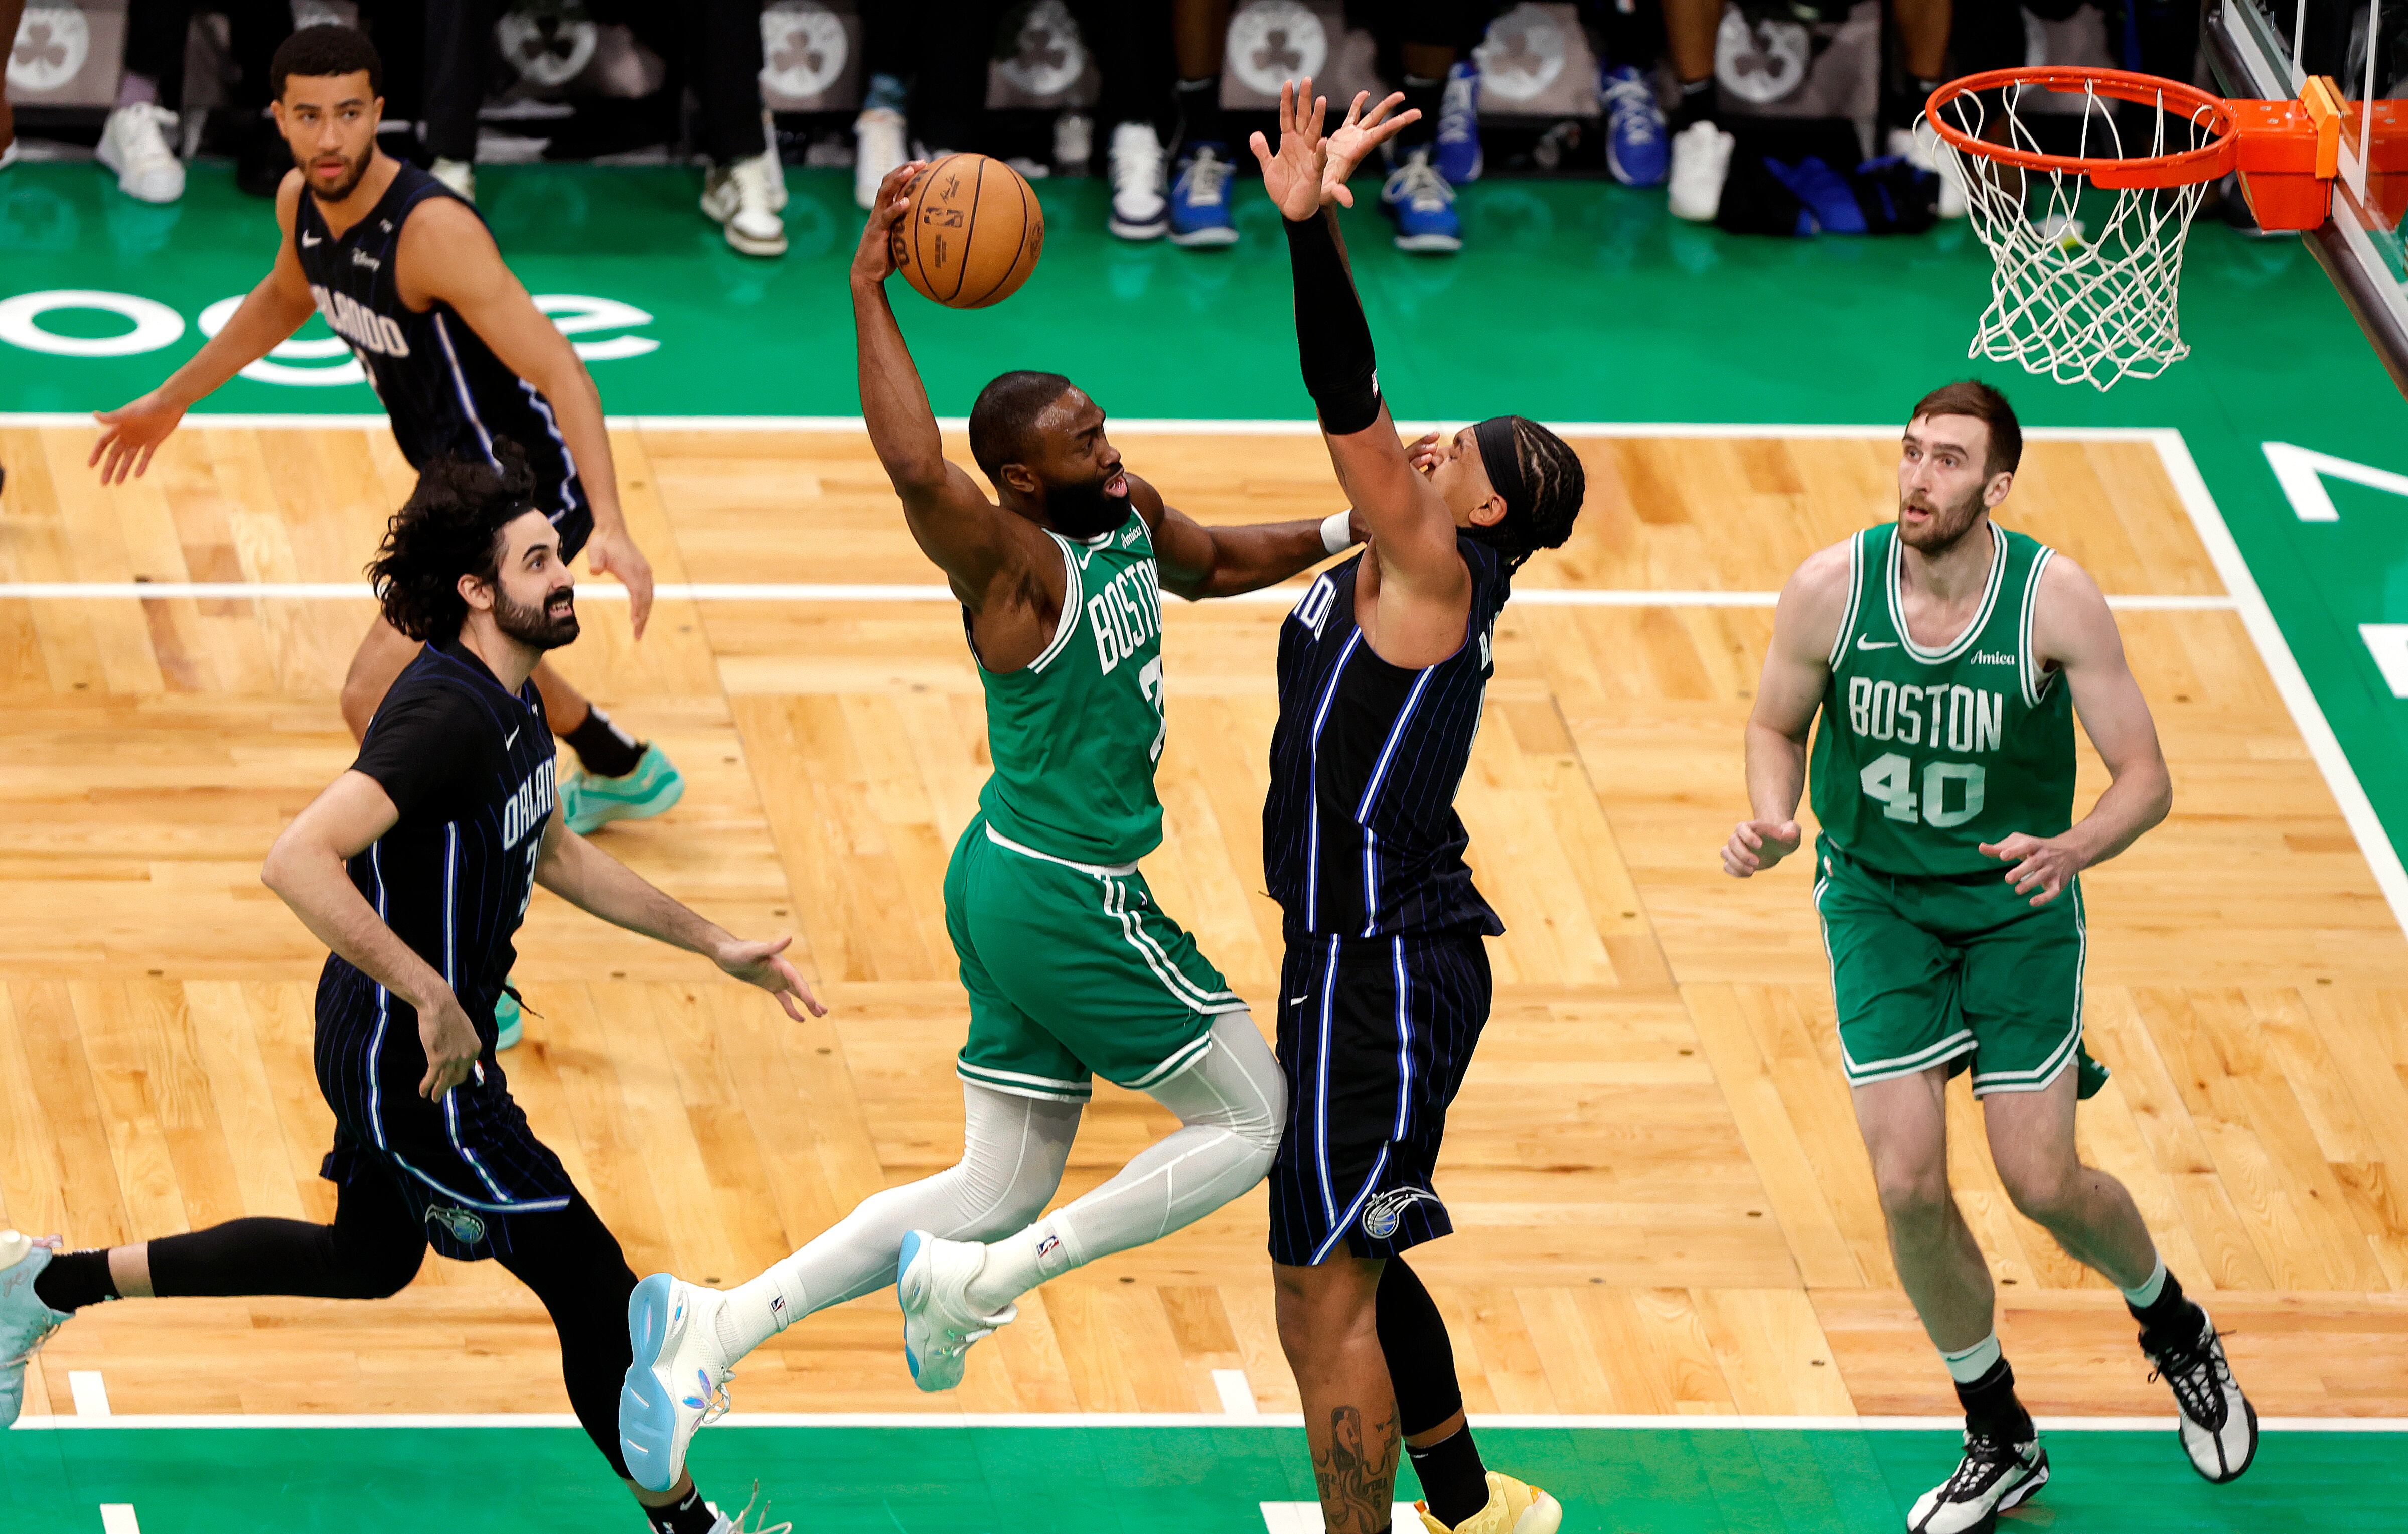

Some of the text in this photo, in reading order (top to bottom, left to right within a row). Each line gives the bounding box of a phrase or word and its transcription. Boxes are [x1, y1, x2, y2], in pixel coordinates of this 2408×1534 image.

[1121, 525, 1142, 549] Amica
[1971, 649, 2015, 666] Amica
[1139, 654, 1166, 763] 7
[1849, 676, 2003, 753] BOSTON
[504, 754, 556, 850] ORLAN
[1860, 752, 1986, 828] 40
[518, 837, 539, 918] 3
